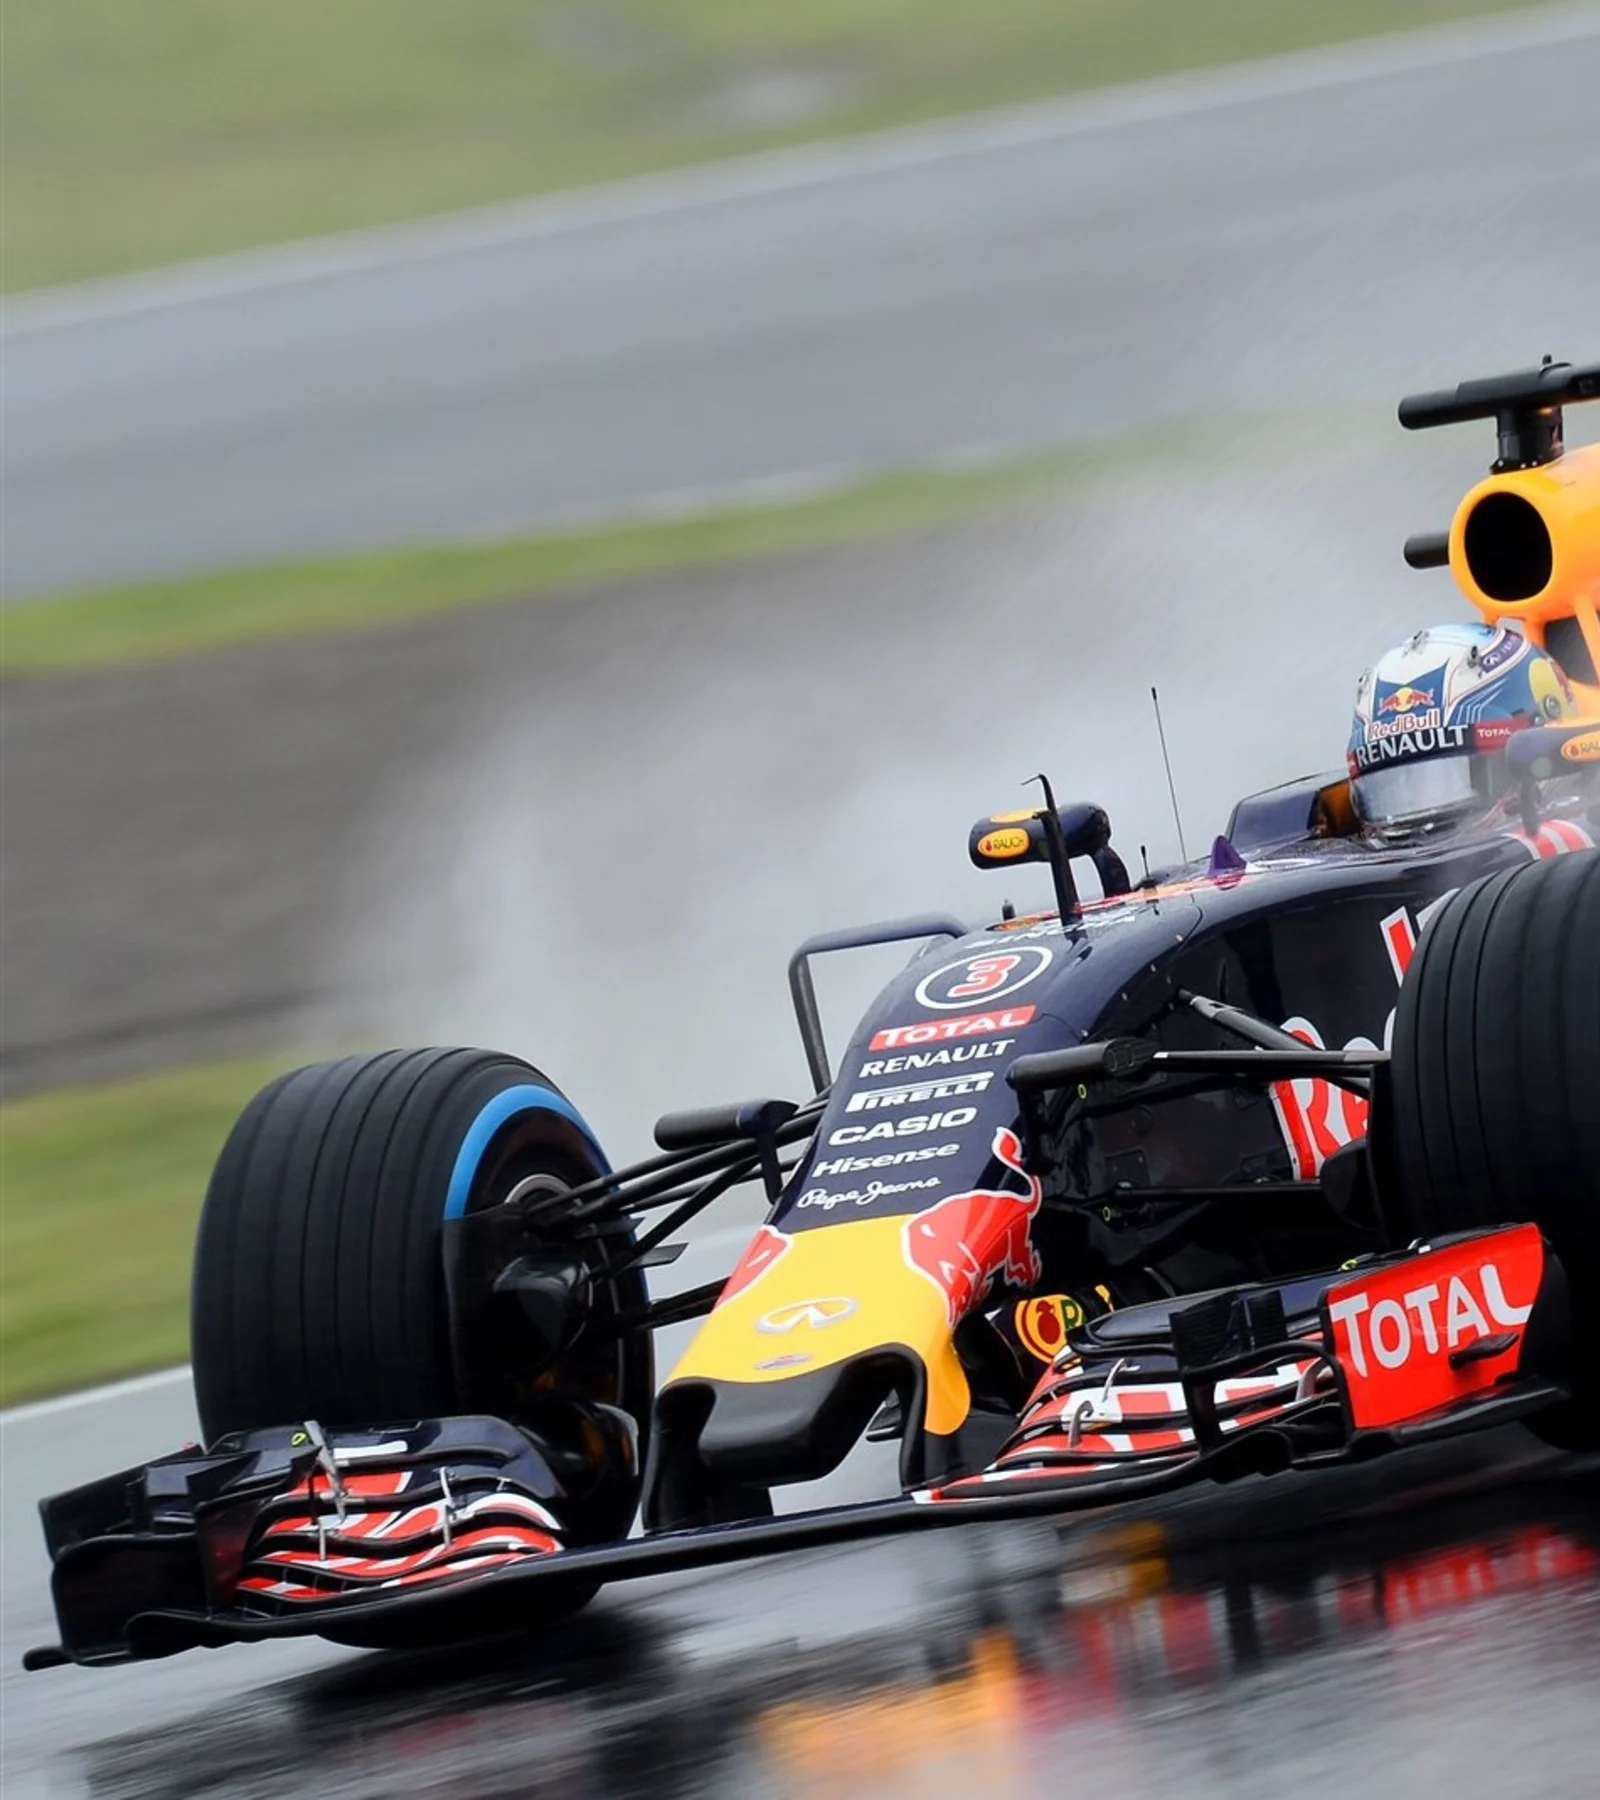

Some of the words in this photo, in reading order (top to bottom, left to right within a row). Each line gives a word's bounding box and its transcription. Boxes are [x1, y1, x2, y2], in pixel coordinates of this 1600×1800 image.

[1368, 714, 1401, 741] Red
[1402, 708, 1441, 732] Bull
[1477, 727, 1512, 738] TOTAL
[1356, 724, 1468, 767] RENAULT
[947, 954, 1020, 998] 3
[877, 1010, 1029, 1048] TOTAL
[858, 1038, 1015, 1078] RENAULT
[844, 1071, 994, 1113] PIRELLI
[828, 1107, 977, 1147] CASIO
[811, 1142, 960, 1179] Hisense
[798, 1185, 859, 1210] Pepe
[857, 1176, 942, 1204] Jeans
[1329, 1263, 1533, 1378] TOTAL
